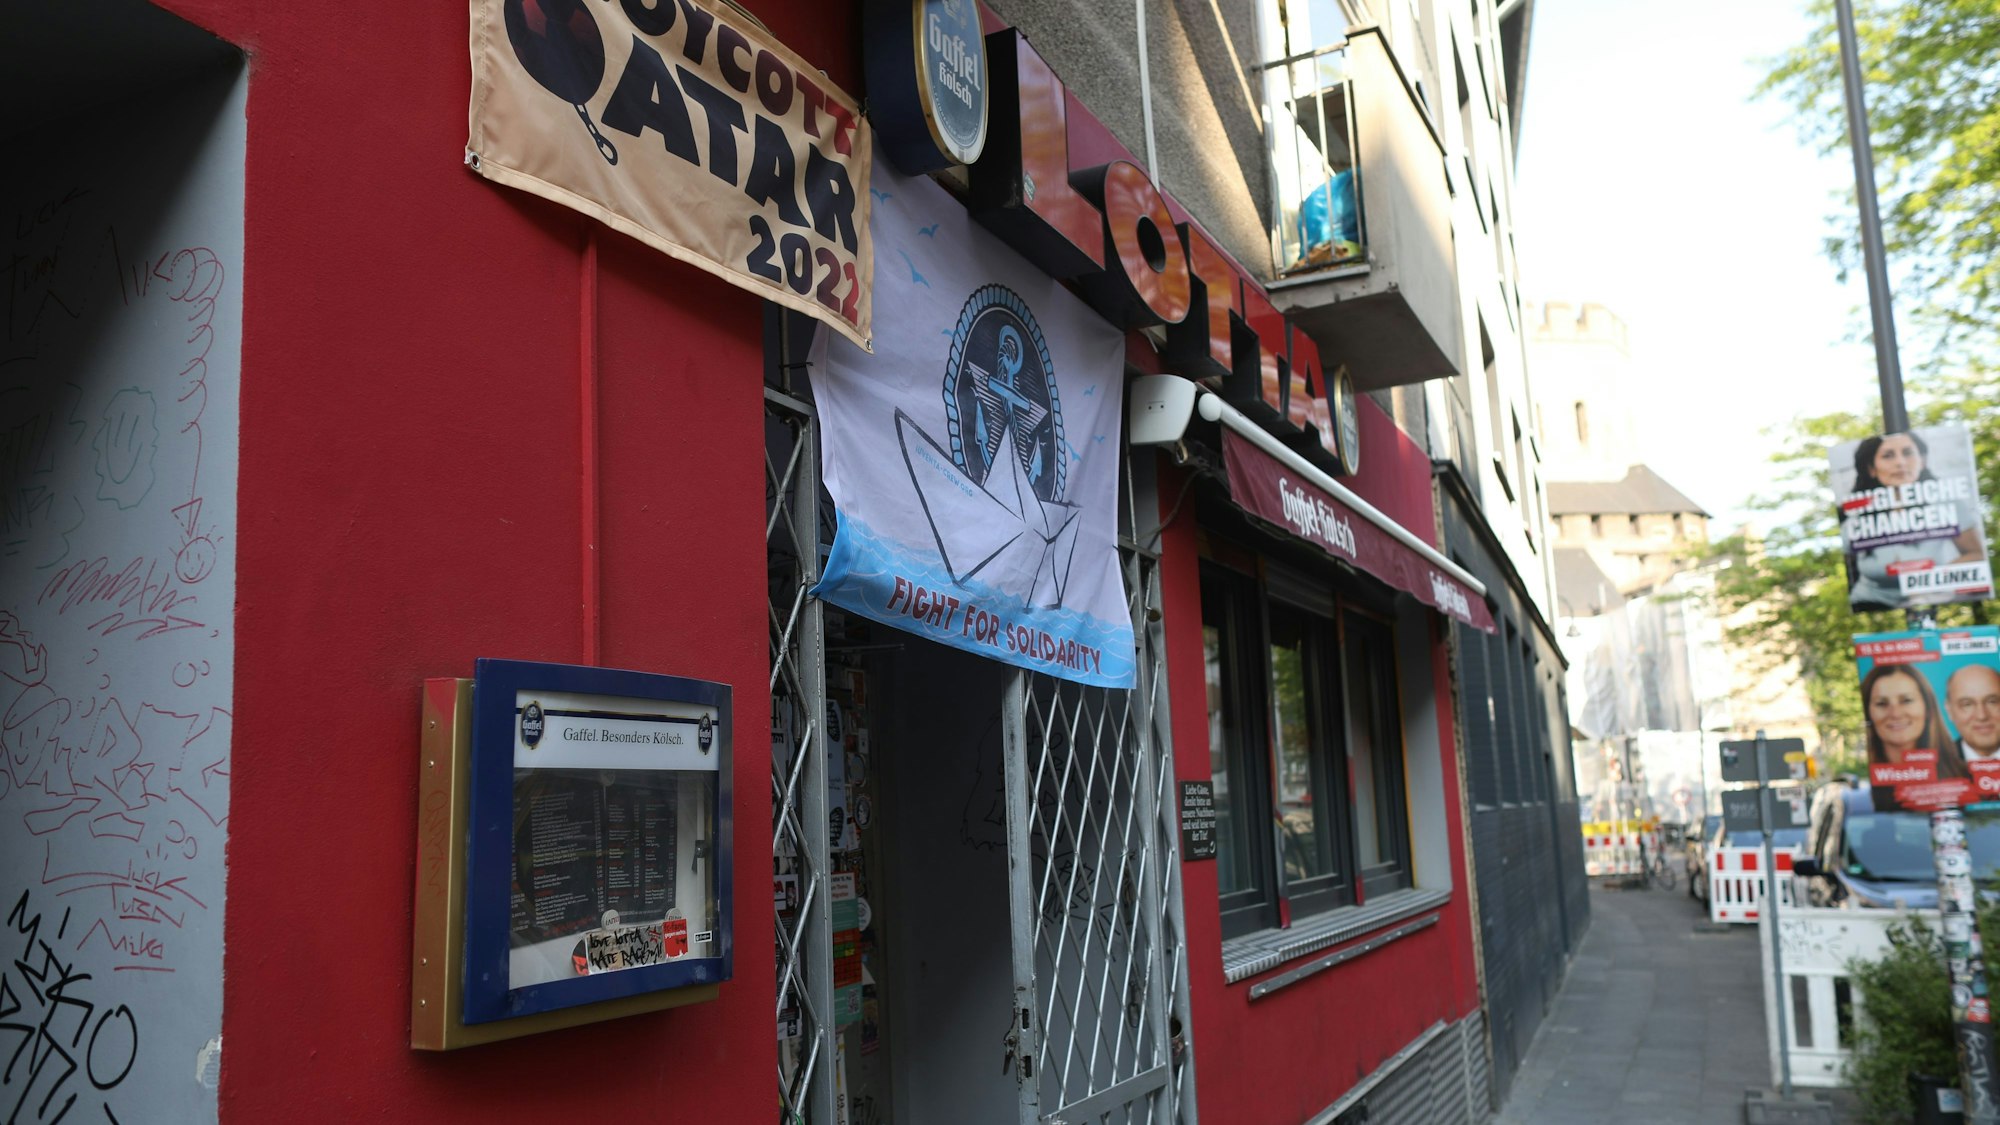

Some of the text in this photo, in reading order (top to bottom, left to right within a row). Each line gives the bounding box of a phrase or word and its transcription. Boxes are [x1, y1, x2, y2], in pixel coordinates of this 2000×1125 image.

[929, 13, 981, 91] Gaffel
[939, 61, 972, 110] Kölsch
[1014, 27, 1338, 460] LOTTA
[746, 214, 860, 327] 2022
[1850, 502, 1959, 541] CHANCEN
[1907, 573, 1931, 588] DIE
[886, 575, 1101, 675] FIGHT FOR SOLIDARITY
[563, 727, 685, 745] Gaffel. Besonders Kölsch.
[1874, 766, 1930, 783] Wissler
